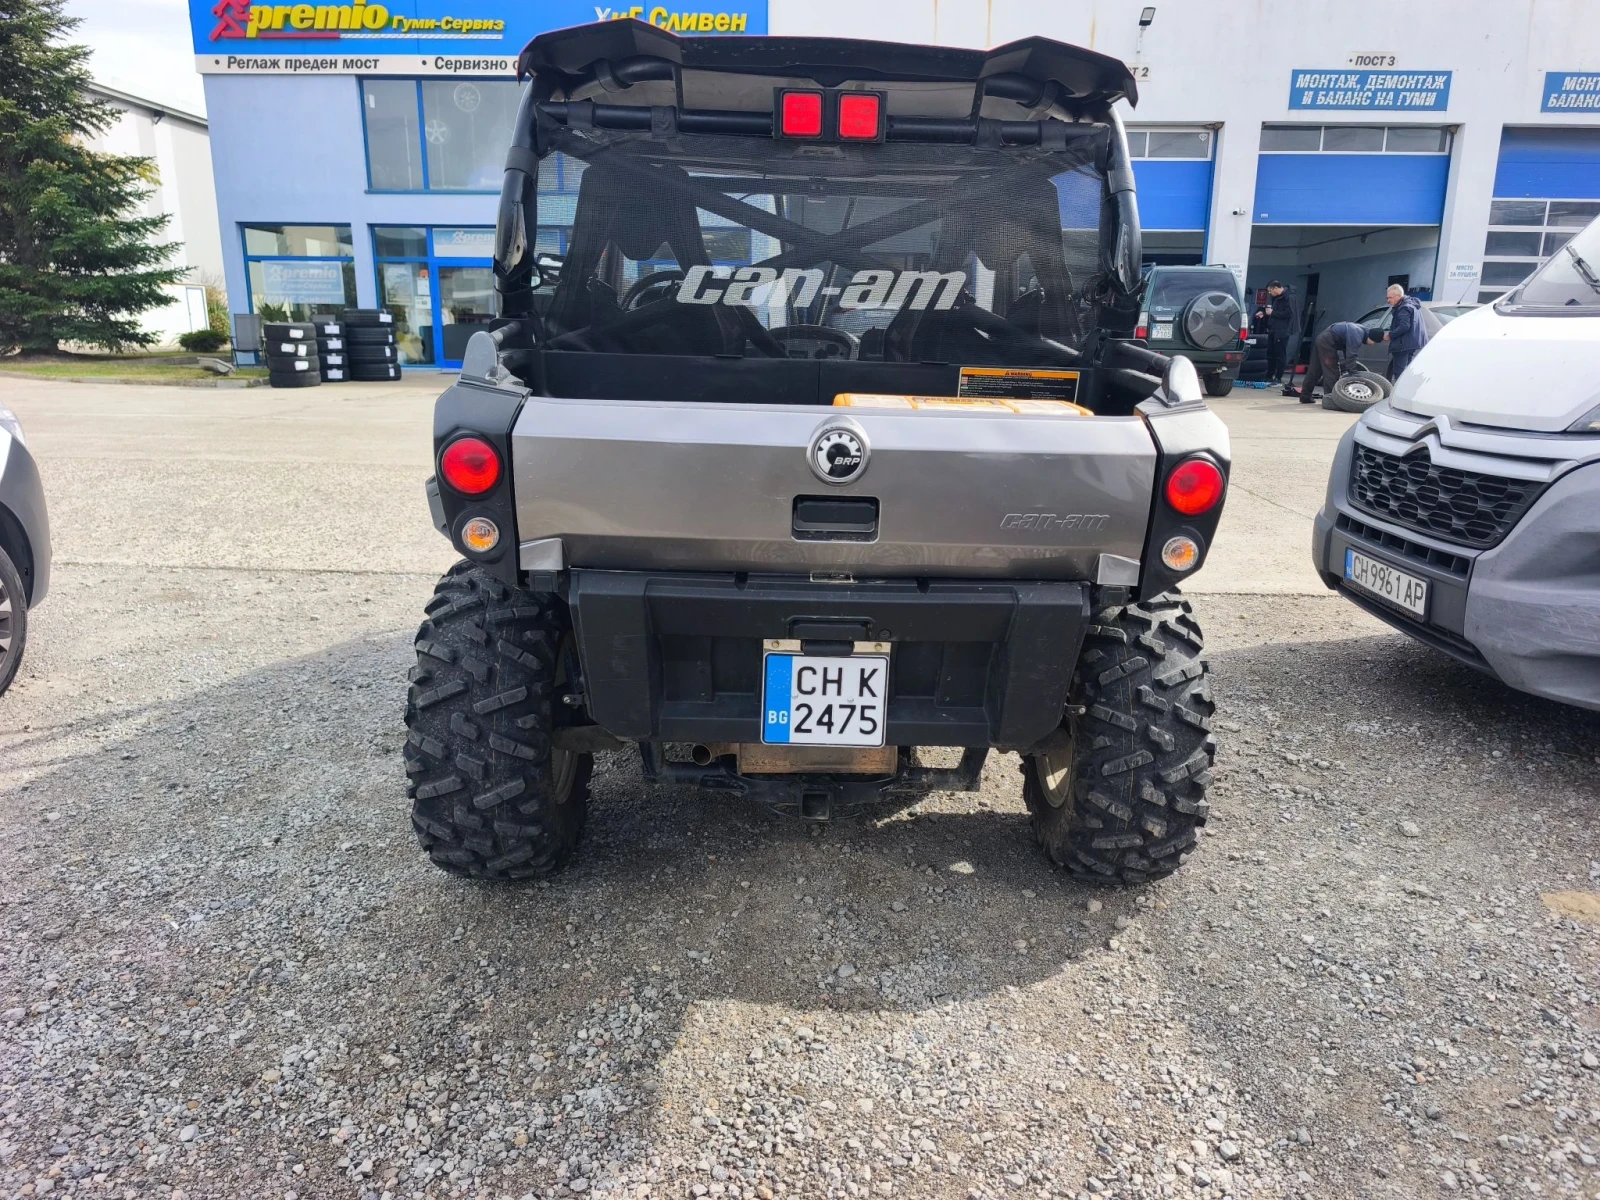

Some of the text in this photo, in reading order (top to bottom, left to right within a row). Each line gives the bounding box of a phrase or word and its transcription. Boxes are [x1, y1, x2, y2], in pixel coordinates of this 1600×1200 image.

[246, 0, 389, 38] premio
[392, 15, 505, 33] Гуми-Сервиз
[650, 7, 747, 31] Сливен
[227, 55, 380, 71] Реглаж преден мост
[434, 56, 508, 72] Сервизно
[1354, 56, 1396, 66] ПОСТ 3
[1140, 66, 1149, 77] 2
[1364, 75, 1448, 91] ДЕМОНТАЖ
[1301, 91, 1437, 106] И БАЛАНС НА ГУМИ
[675, 265, 967, 310] can-am
[834, 456, 861, 466] BRP
[1000, 513, 1110, 531] can-am
[797, 666, 879, 698] CH K
[768, 710, 789, 724] BG
[794, 703, 878, 735] 2475
